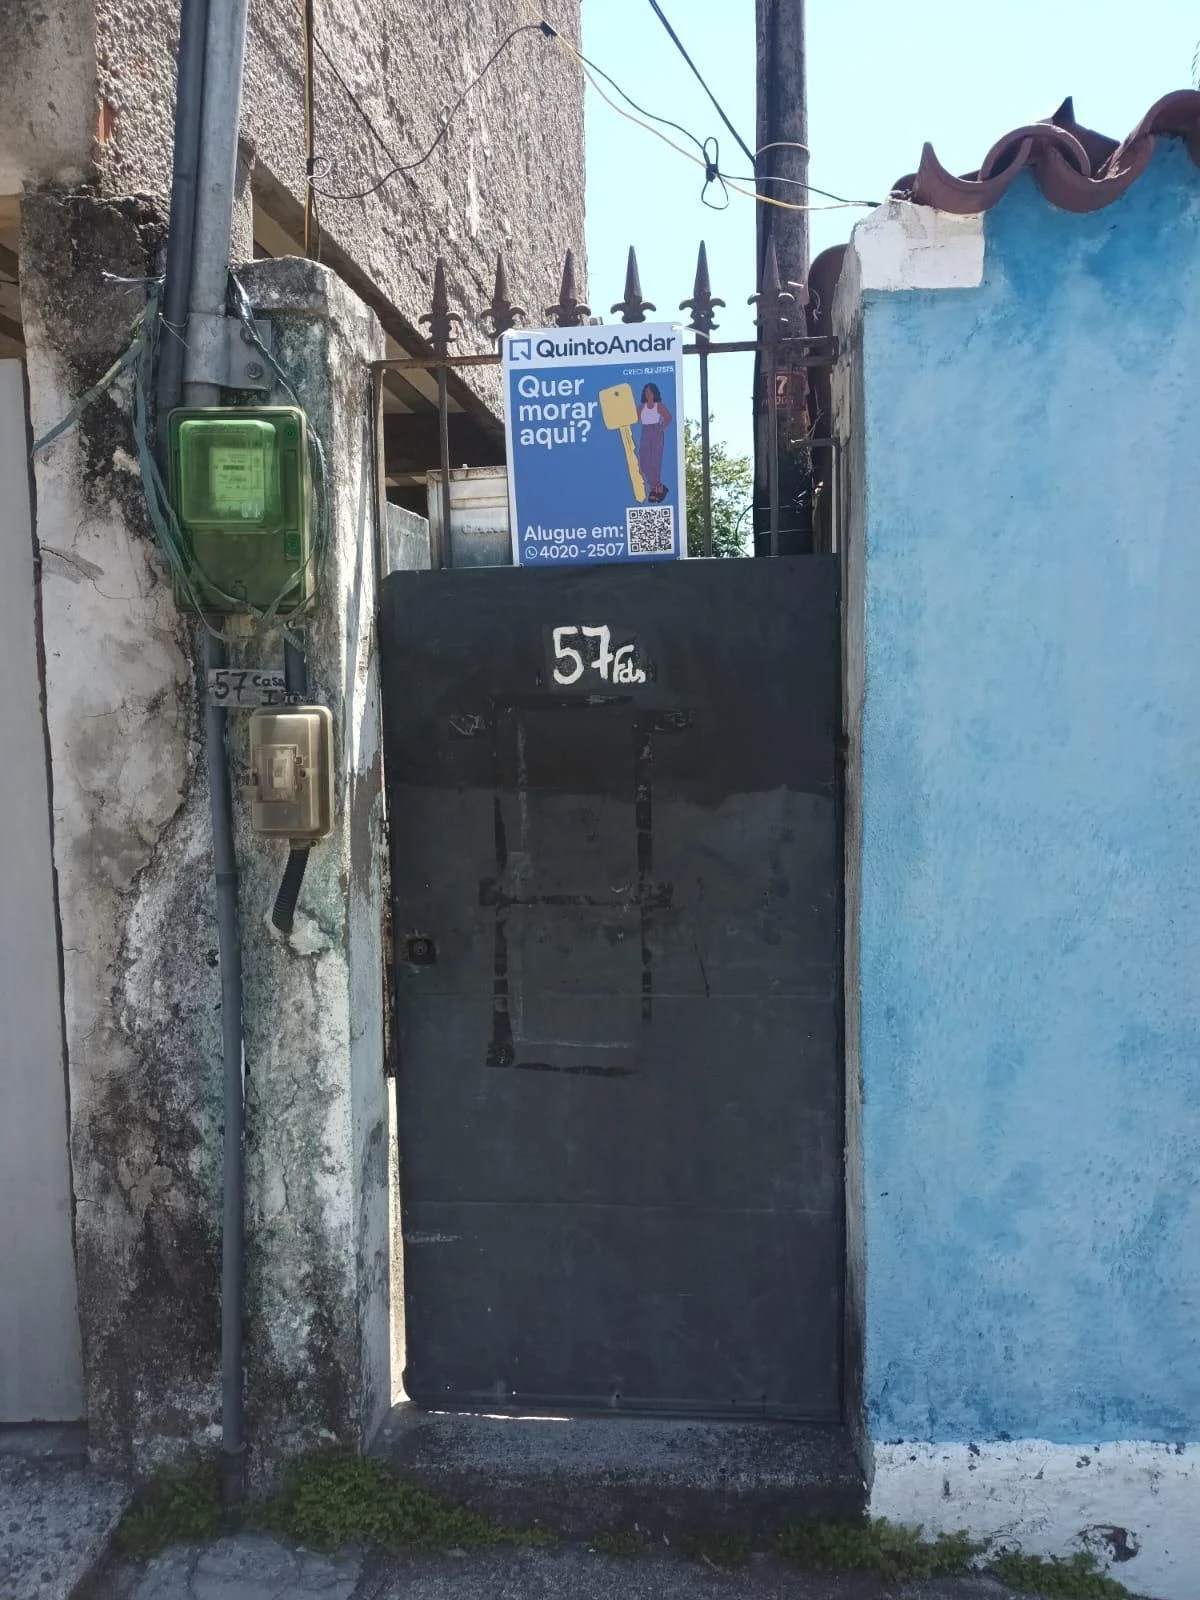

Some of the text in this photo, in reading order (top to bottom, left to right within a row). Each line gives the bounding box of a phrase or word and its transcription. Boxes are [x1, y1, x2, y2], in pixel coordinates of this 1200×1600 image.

[536, 334, 676, 358] QuintoAndar
[518, 375, 585, 398] Quer
[519, 401, 598, 422] morar
[520, 420, 591, 450] aqui?
[524, 525, 587, 544] Alugue
[591, 526, 624, 539] em:
[539, 543, 625, 559] 4020-2507
[552, 625, 614, 685] 57
[214, 671, 248, 703] 57
